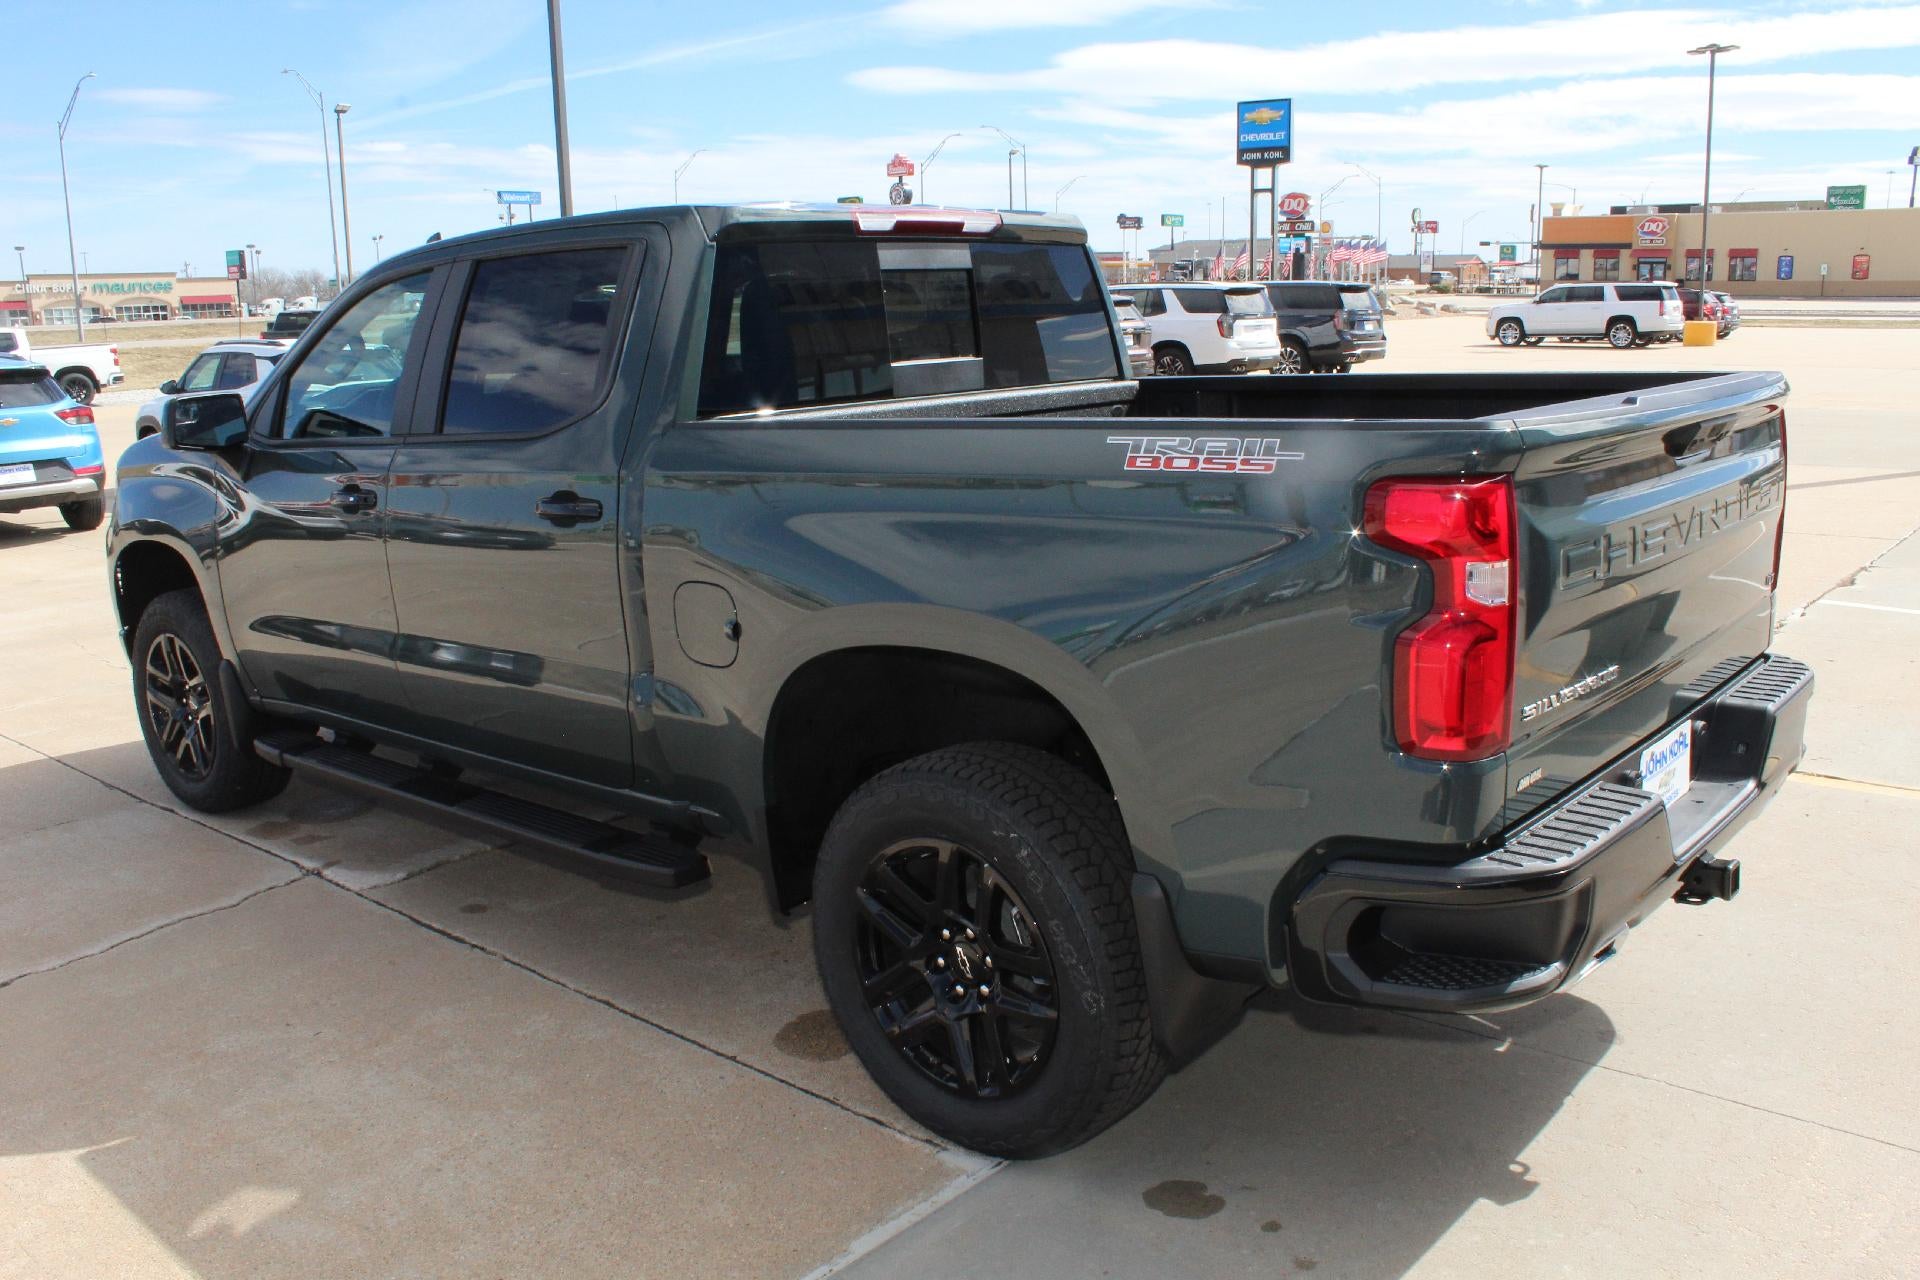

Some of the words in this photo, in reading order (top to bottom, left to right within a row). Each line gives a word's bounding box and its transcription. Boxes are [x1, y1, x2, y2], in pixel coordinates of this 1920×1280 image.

[1240, 132, 1286, 142] CHEVROLET
[1242, 152, 1261, 160] JOHN
[1264, 151, 1284, 159] KOHL
[1283, 198, 1305, 212] DQ
[1643, 221, 1662, 233] DQ
[91, 280, 174, 294] maurices
[1107, 436, 1305, 460] TRAIL
[1124, 453, 1277, 474] BOSS
[1560, 472, 1784, 591] CHEVROLET
[1641, 747, 1668, 780] JOHN
[1669, 732, 1689, 759] KOHL
